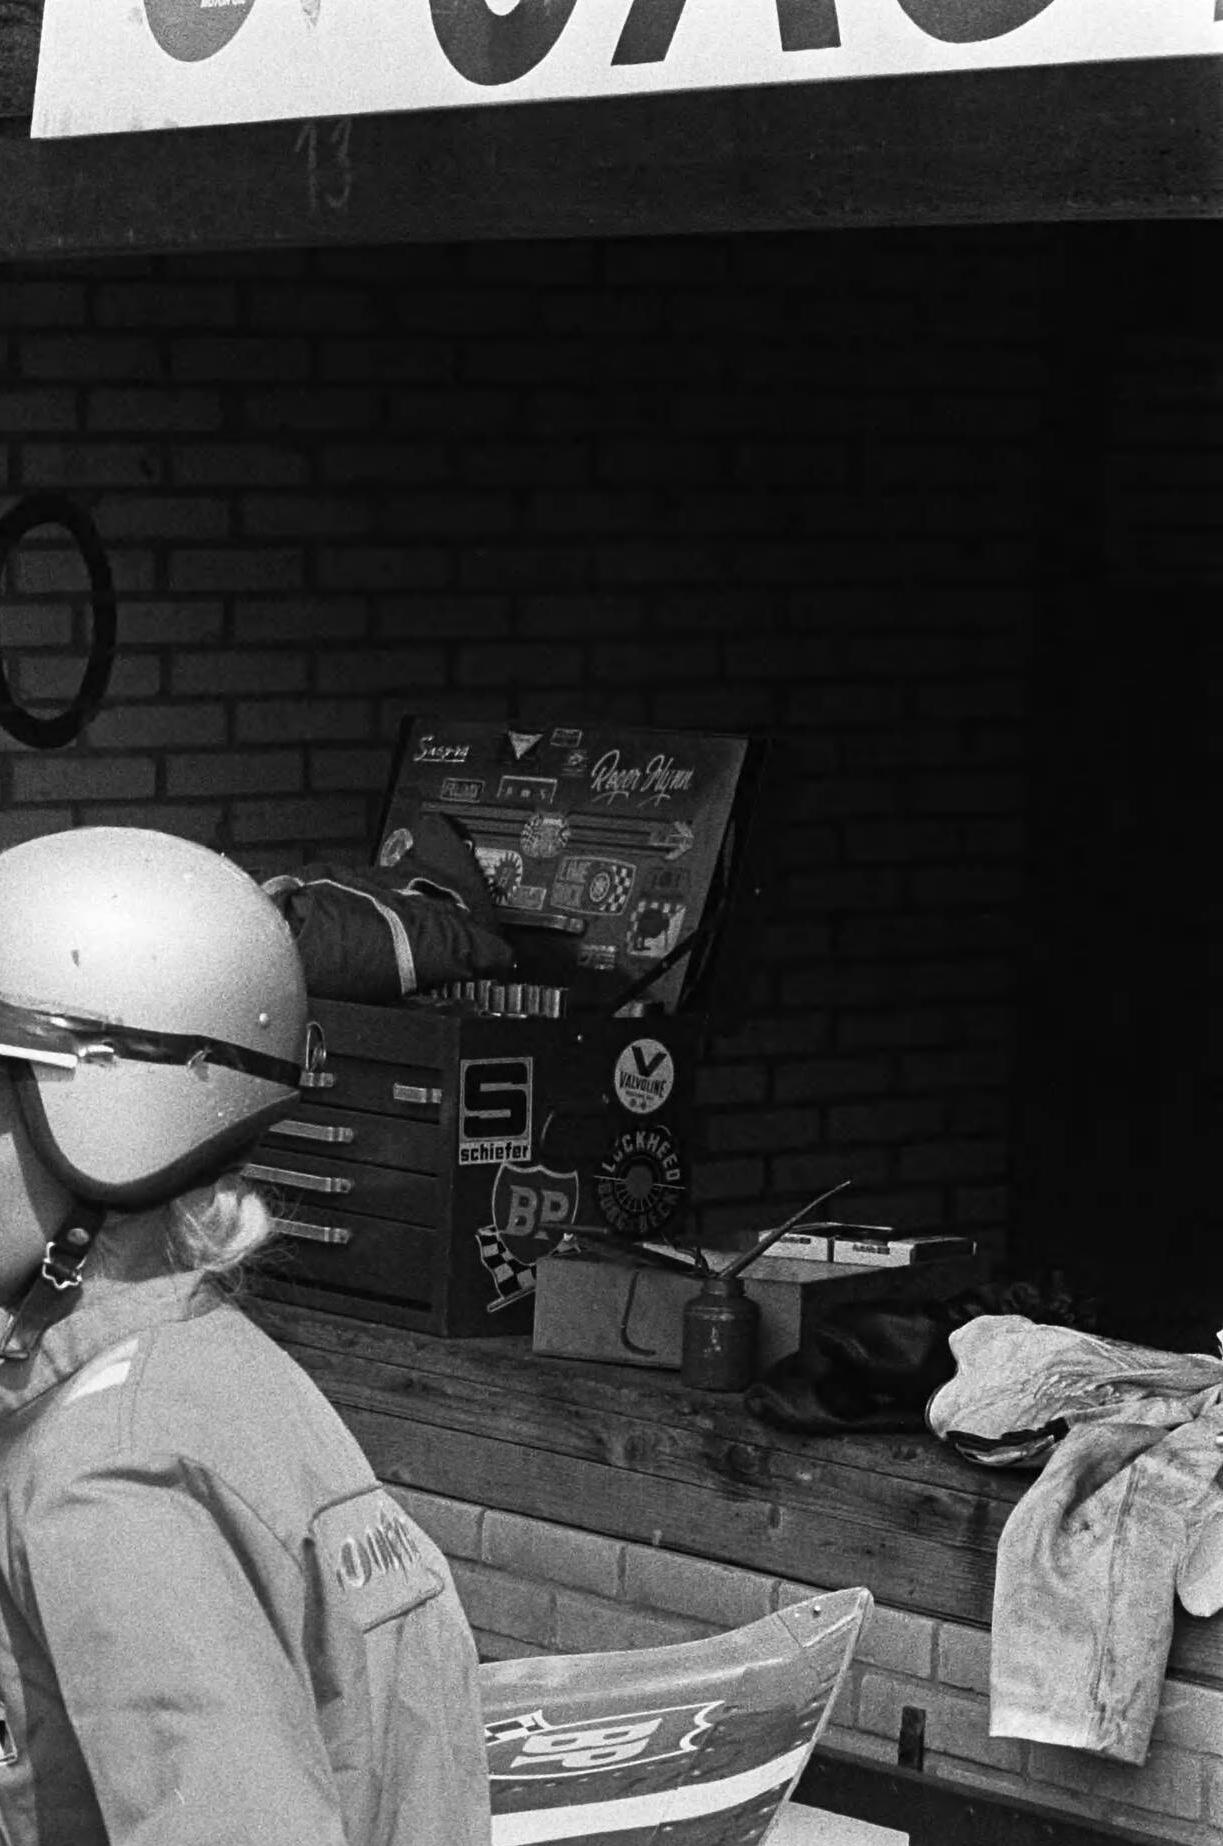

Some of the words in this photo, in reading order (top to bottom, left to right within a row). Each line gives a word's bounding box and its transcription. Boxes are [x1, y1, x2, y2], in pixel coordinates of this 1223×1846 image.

[619, 1071, 667, 1098] VALVOLINE
[461, 1143, 530, 1162] schiefer
[503, 1184, 570, 1241] BP
